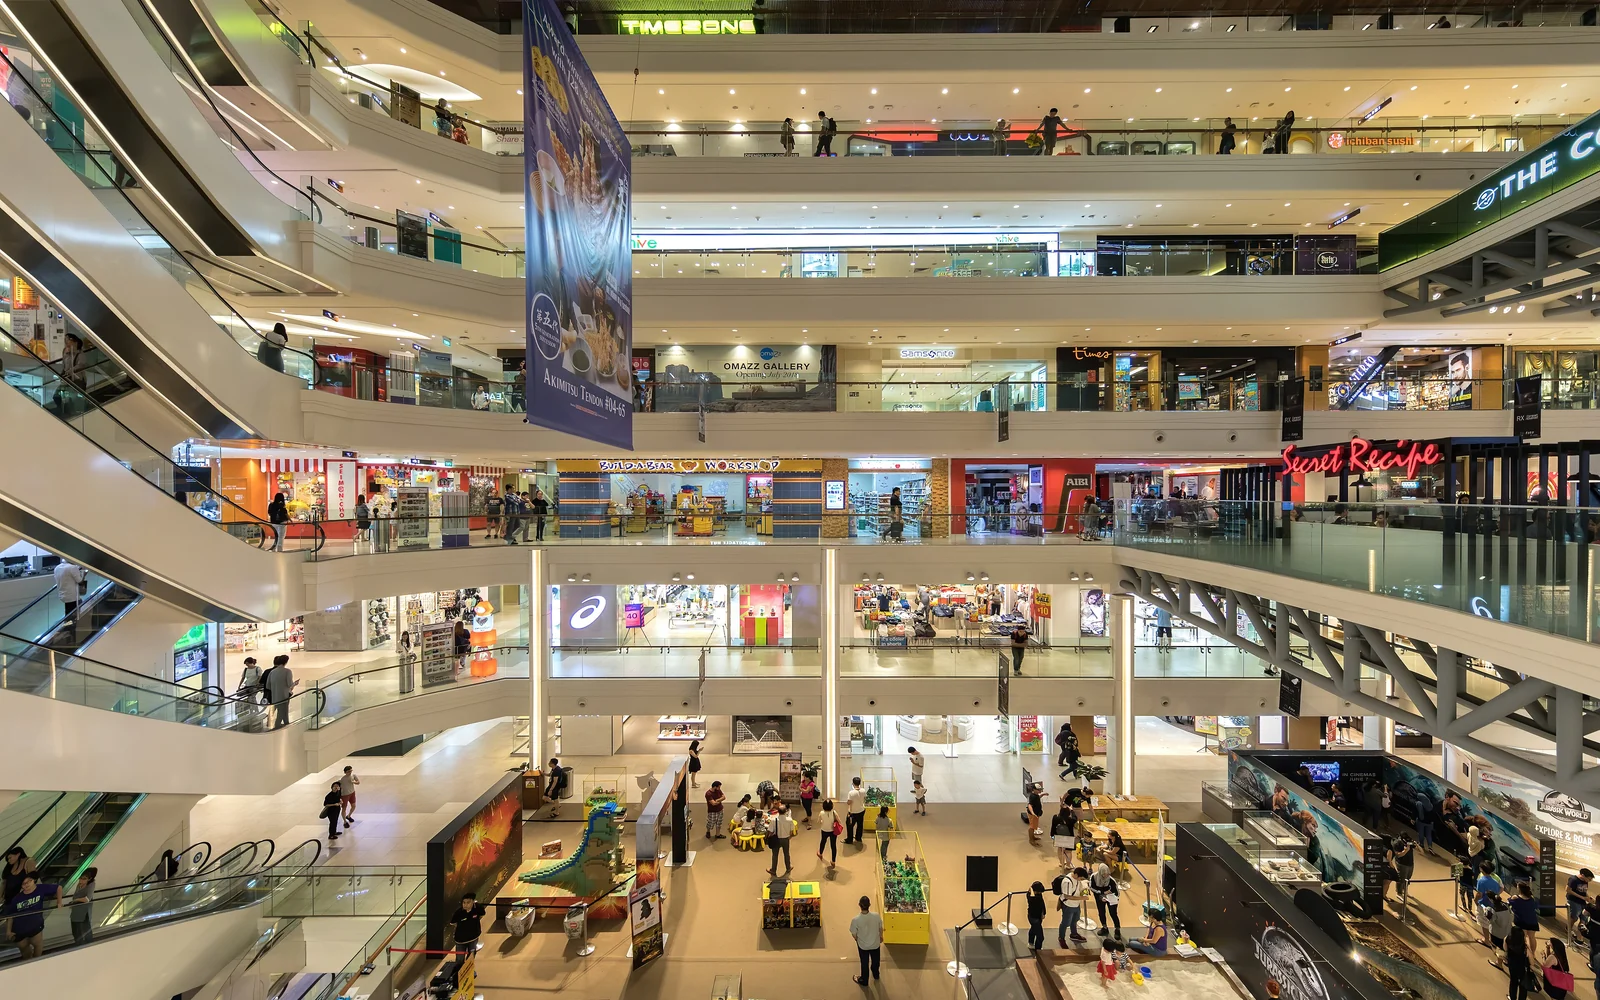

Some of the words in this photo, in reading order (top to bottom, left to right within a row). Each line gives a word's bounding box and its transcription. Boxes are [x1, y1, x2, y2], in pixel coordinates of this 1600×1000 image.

[621, 20, 756, 34] TIMEZONE
[1345, 136, 1385, 146] ichiban
[1387, 136, 1415, 146] sushi
[1500, 151, 1557, 198] THE
[1570, 128, 1600, 160] C
[901, 350, 955, 358] Samsonite
[1072, 346, 1112, 360] times
[723, 362, 760, 371] OMAZZ
[763, 362, 811, 371] GALLERY
[735, 371, 767, 380] Opening
[767, 371, 783, 380] July
[543, 367, 579, 398] AKIMITSU
[580, 384, 604, 409] TENDON
[604, 395, 626, 418] #04-65
[1282, 444, 1345, 475] Secret
[1350, 438, 1444, 480] Recipe
[1066, 478, 1089, 486] AIBI
[626, 612, 638, 620] 40
[1538, 801, 1564, 815] JURASSIC
[1564, 807, 1589, 820] WORLD
[1534, 824, 1564, 841] EXPLORE
[1565, 831, 1572, 841] &
[1573, 833, 1593, 846] ROAR
[1253, 941, 1300, 1000] JURASSIC
